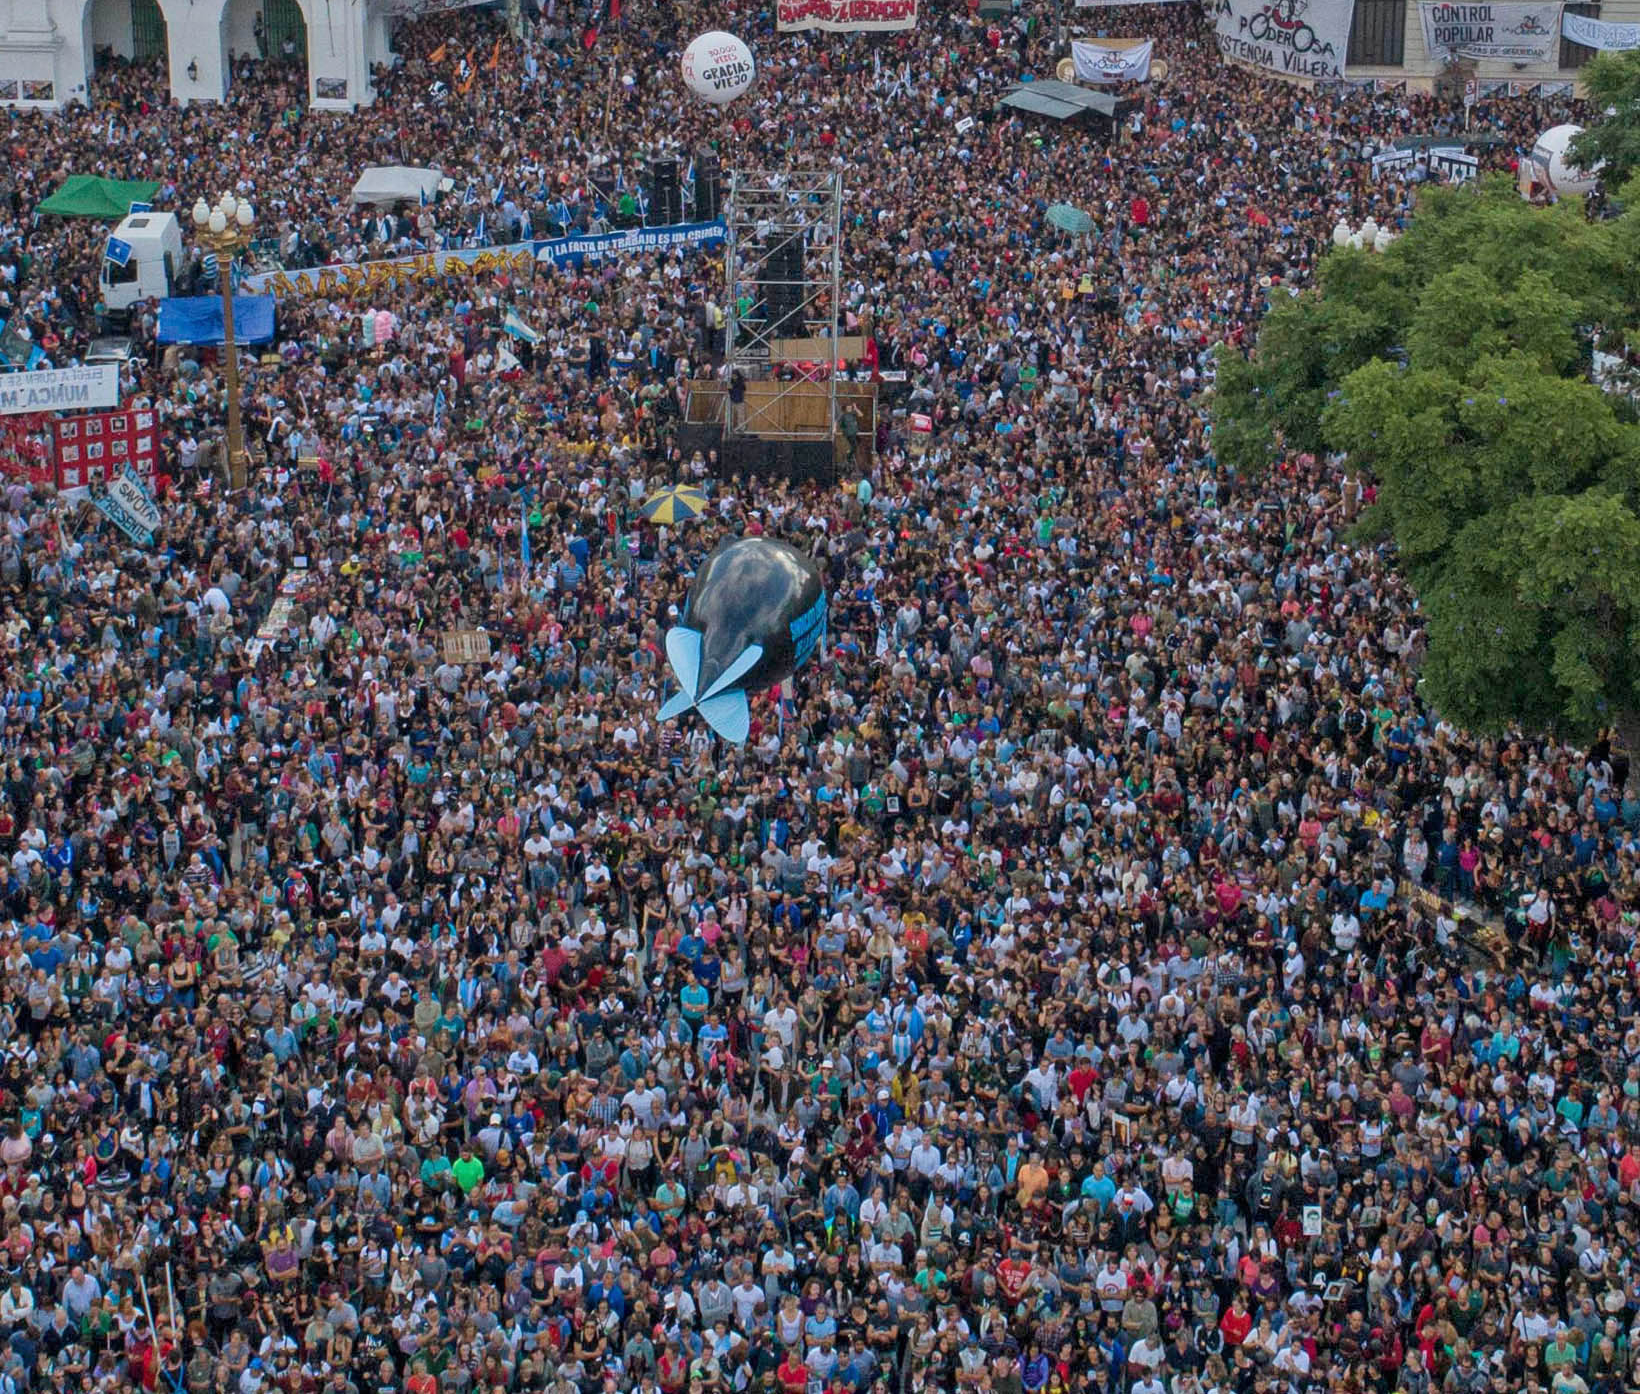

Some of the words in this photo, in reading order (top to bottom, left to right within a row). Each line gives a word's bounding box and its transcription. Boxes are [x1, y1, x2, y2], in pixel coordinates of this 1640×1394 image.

[1432, 5, 1495, 24] CONTROL
[1240, 12, 1336, 56] PODEROSA
[1434, 26, 1495, 45] POPULAR
[1282, 50, 1344, 79] VILLERA
[714, 73, 748, 90] VIEJO
[555, 244, 567, 256] LA
[568, 241, 596, 254] FALTA
[597, 239, 609, 251] DE
[612, 233, 657, 249] TRABAJO
[658, 233, 670, 245] ES
[672, 231, 685, 243] UN
[687, 226, 724, 242] CRIMEN
